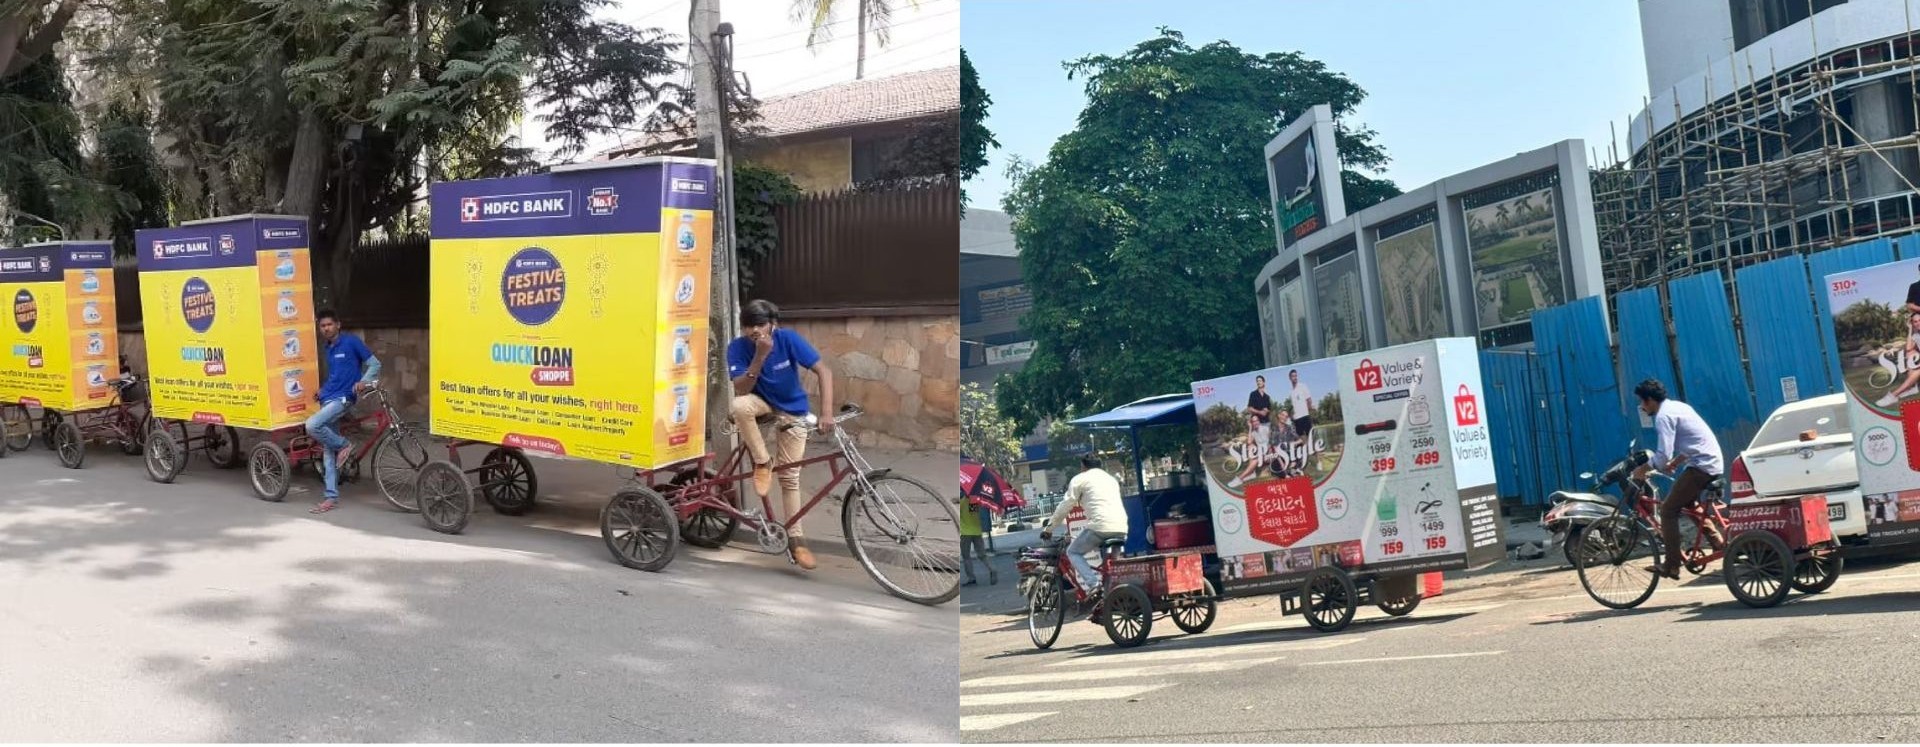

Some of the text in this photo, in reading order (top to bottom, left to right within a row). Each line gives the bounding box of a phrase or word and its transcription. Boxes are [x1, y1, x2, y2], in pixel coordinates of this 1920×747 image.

[484, 198, 564, 215] HDFC BANK
[593, 196, 611, 207] No.1
[507, 268, 563, 290] FESTIVE
[1832, 280, 1857, 292] 310+
[508, 287, 561, 307] TREATS
[186, 305, 213, 321] TREATS
[538, 370, 570, 382] SHOPPE
[1358, 371, 1378, 386] V2
[1383, 373, 1423, 387] Variety
[440, 380, 457, 392] Best
[459, 383, 476, 394] loan
[477, 385, 501, 397] offers
[503, 388, 515, 399] for
[517, 390, 528, 401] all
[530, 392, 550, 404] your
[552, 394, 587, 408] wishes,
[589, 399, 612, 412] right
[1457, 401, 1475, 420] V2
[1270, 427, 1326, 473] Style
[1455, 445, 1487, 460] Variety
